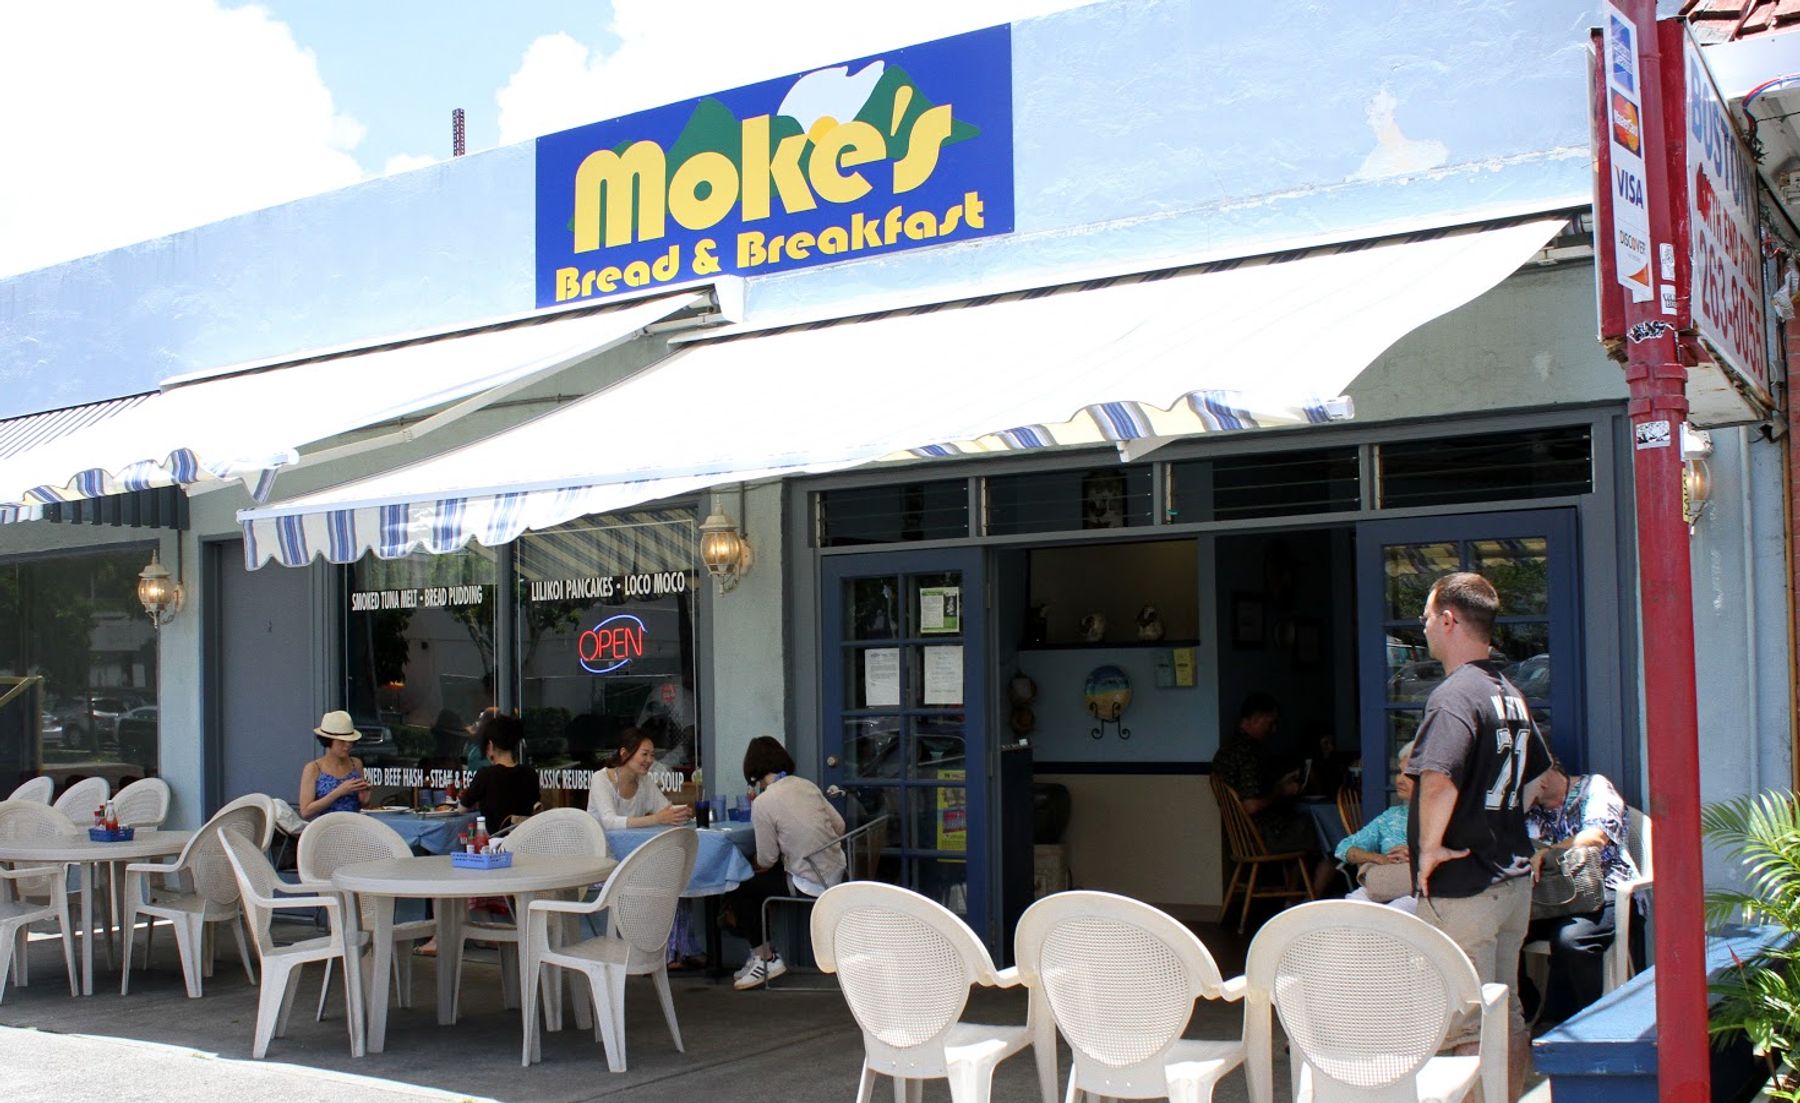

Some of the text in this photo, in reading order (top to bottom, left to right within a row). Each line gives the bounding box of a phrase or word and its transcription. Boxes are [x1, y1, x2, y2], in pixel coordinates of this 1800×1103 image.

[1615, 165, 1644, 210] VISA
[555, 191, 984, 302] Bread & Breakfast
[1619, 229, 1646, 255] DISCOVER
[1700, 229, 1763, 381] 263-8055
[352, 585, 483, 611] SMOKED TUNA MELT BREAD PUDDING
[531, 571, 685, 601] LILIKOI PANCAKES LOCO MOCO
[578, 626, 643, 661] OPEN
[363, 767, 383, 786] RNED
[384, 767, 401, 786] BEEF
[403, 768, 424, 788] HASH
[455, 771, 460, 789] &
[539, 769, 561, 790] ASSIC
[660, 771, 684, 793] SOUP
